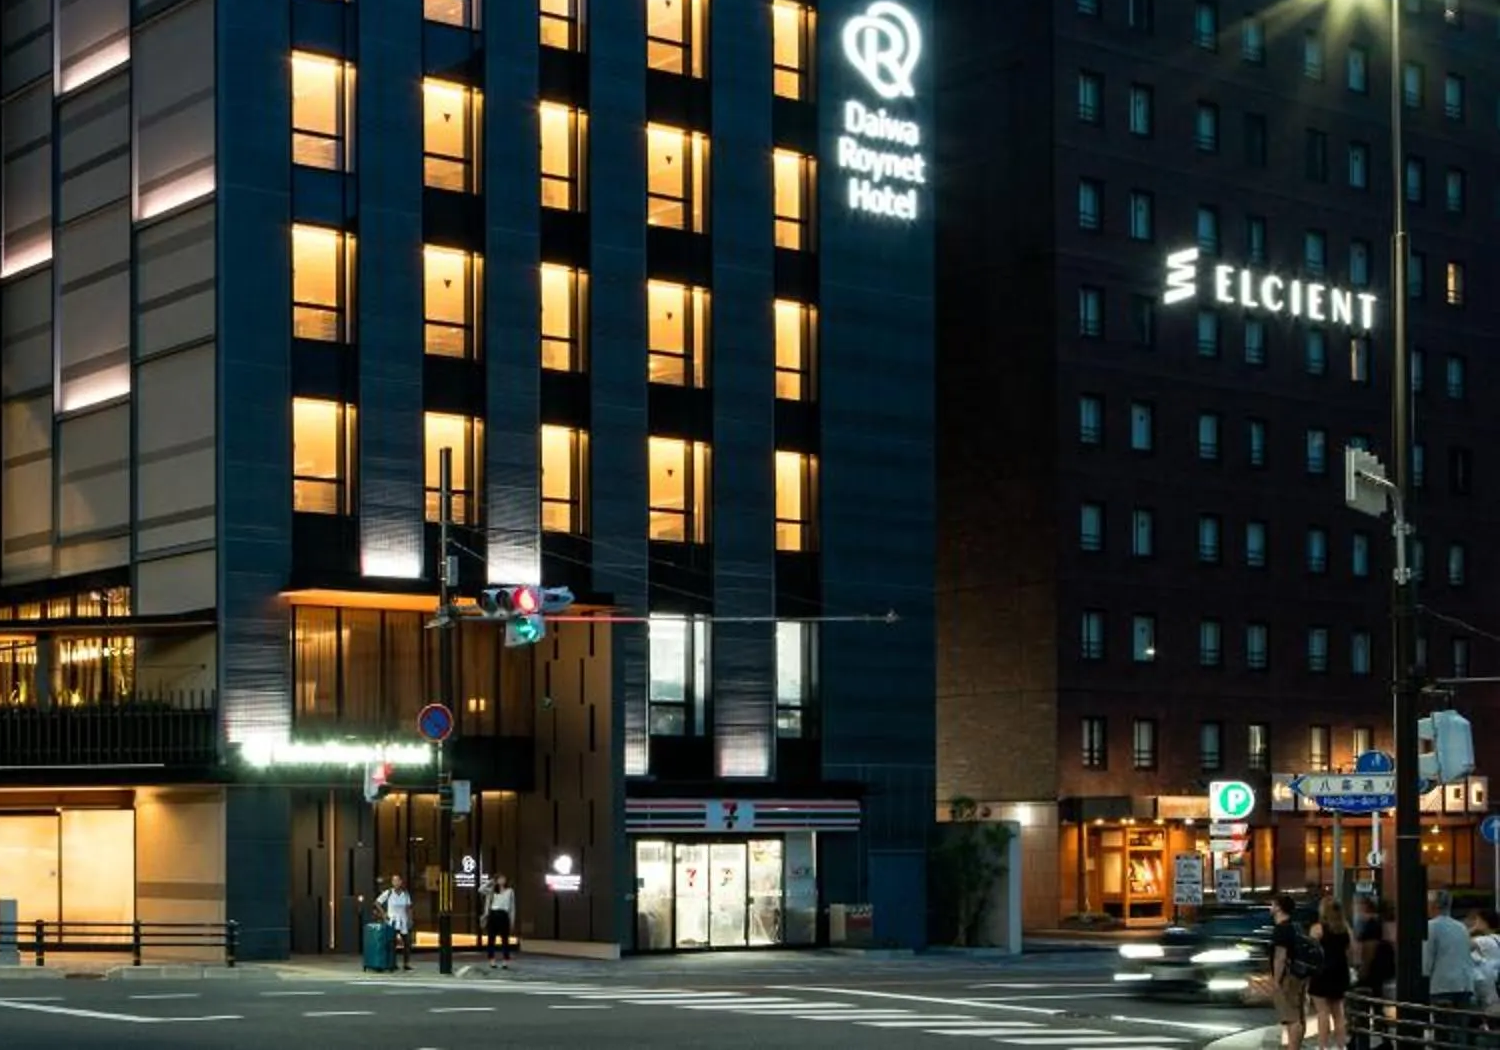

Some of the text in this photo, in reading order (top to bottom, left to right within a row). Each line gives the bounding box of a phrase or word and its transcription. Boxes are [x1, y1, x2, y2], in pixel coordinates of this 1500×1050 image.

[845, 100, 920, 147] Daiwa
[838, 136, 926, 184] Roynet
[848, 177, 917, 220] Hotel
[1214, 264, 1378, 330] ELCIENT
[1226, 789, 1246, 814] P
